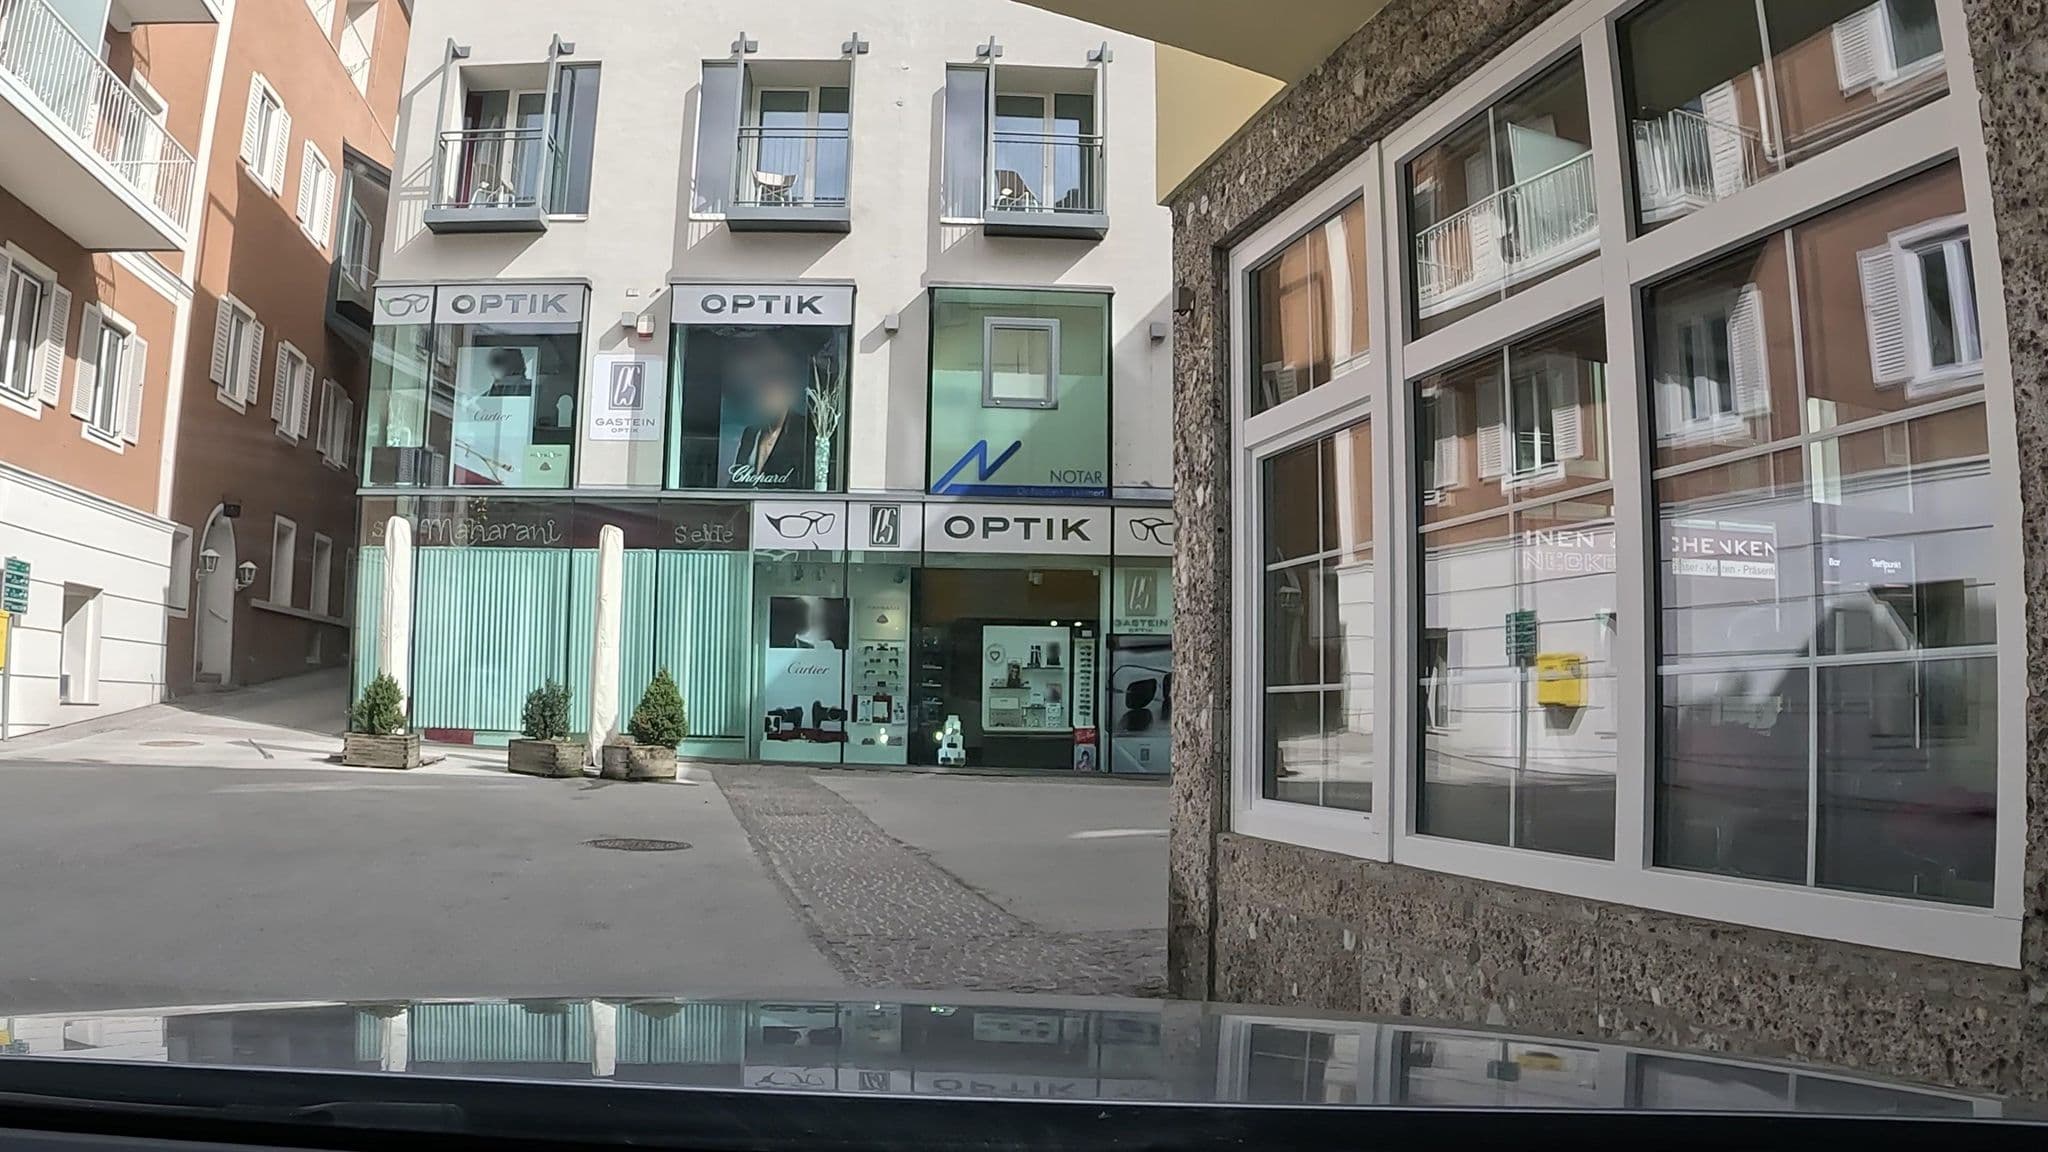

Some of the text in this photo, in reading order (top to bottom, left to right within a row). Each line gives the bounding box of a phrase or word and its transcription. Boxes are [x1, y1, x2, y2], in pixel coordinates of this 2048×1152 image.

[452, 294, 568, 314] OPTIK
[701, 294, 824, 315] OPTIK
[473, 408, 512, 421] Cartier
[595, 417, 656, 427] GASTEIN
[728, 464, 794, 486] Chopard
[1050, 470, 1103, 484] NOTAR
[420, 518, 562, 546] Maharani
[944, 515, 1091, 541] OPTIK
[787, 661, 830, 675] Cartier
